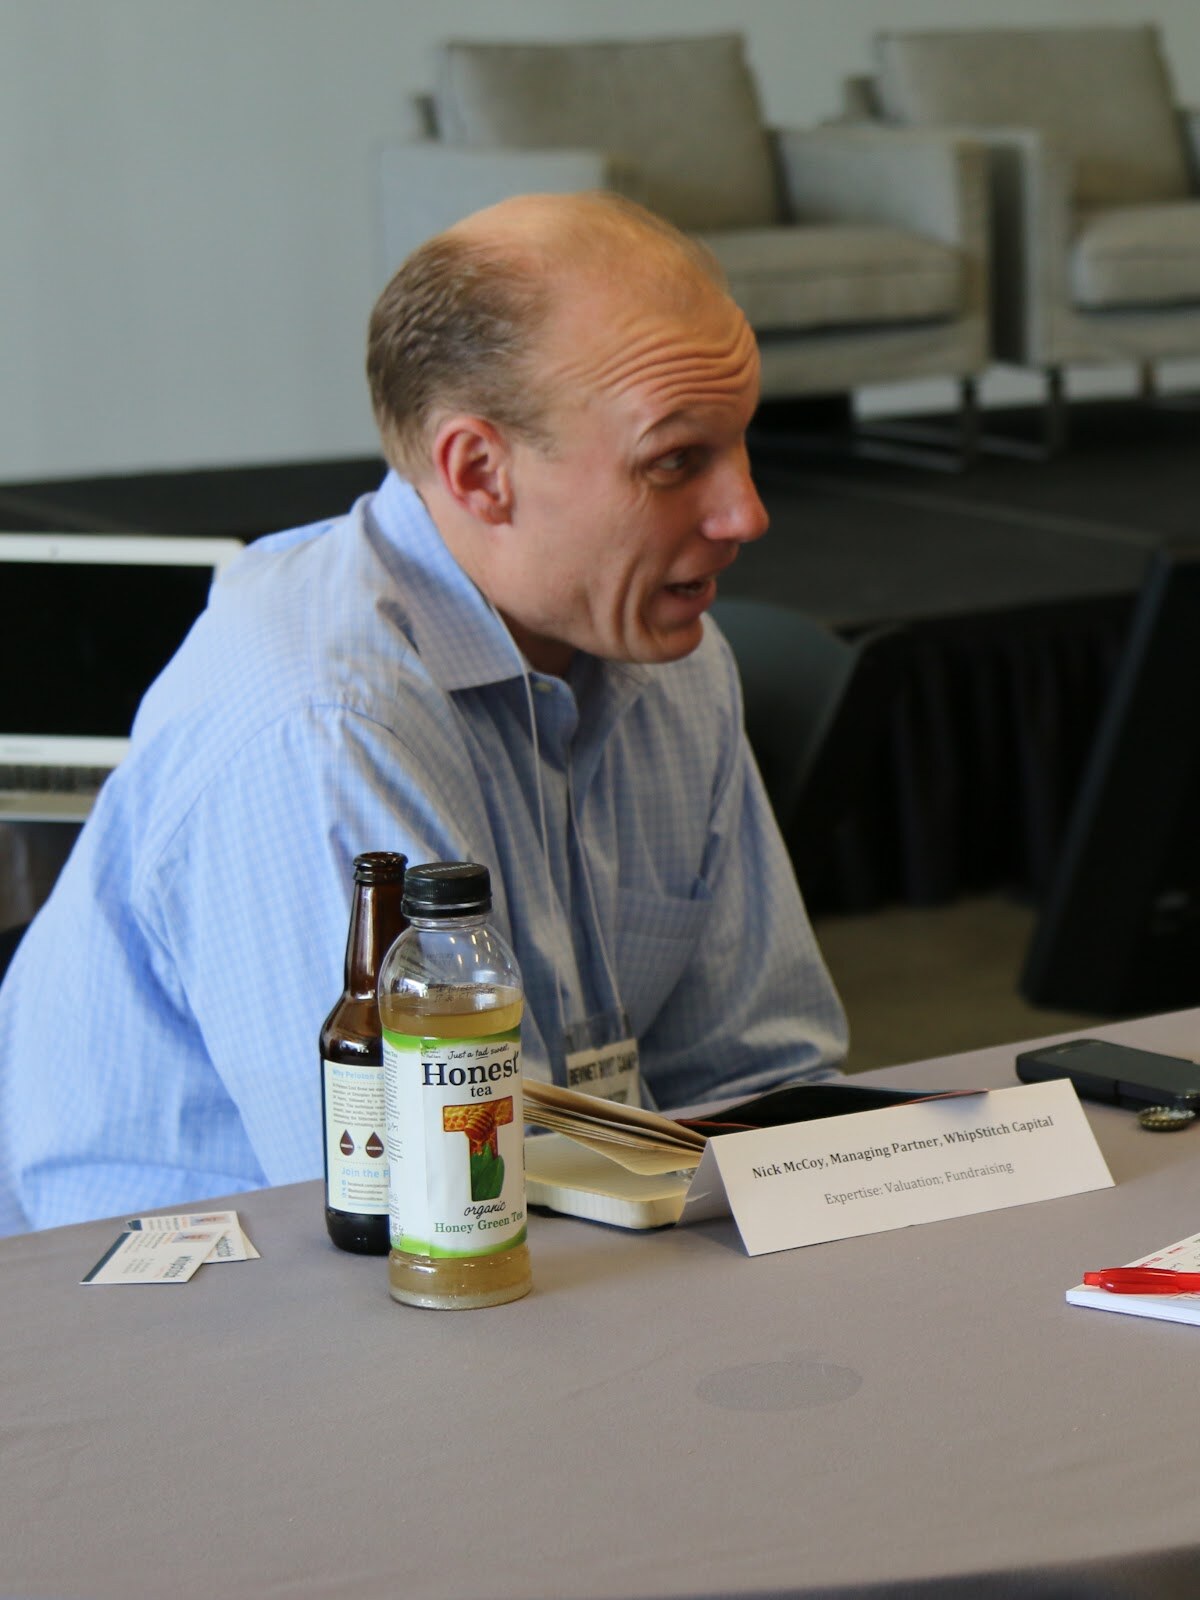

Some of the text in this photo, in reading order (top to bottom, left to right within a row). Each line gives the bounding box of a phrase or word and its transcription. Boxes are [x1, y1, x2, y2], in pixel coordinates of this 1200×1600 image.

[448, 1051, 467, 1060] Just
[475, 1048, 489, 1057] tad
[421, 1052, 519, 1086] Honest
[471, 1085, 493, 1098] tea
[752, 1116, 1054, 1179] Nick McCoy, Managing Partner, WhipStitch Capital
[342, 1168, 360, 1177] Join
[364, 1169, 380, 1178] the
[824, 1162, 1015, 1206] Expertise: Valuation; Fundraising
[464, 1201, 507, 1220] organic
[435, 1223, 475, 1234] Honey
[478, 1217, 510, 1231] Green
